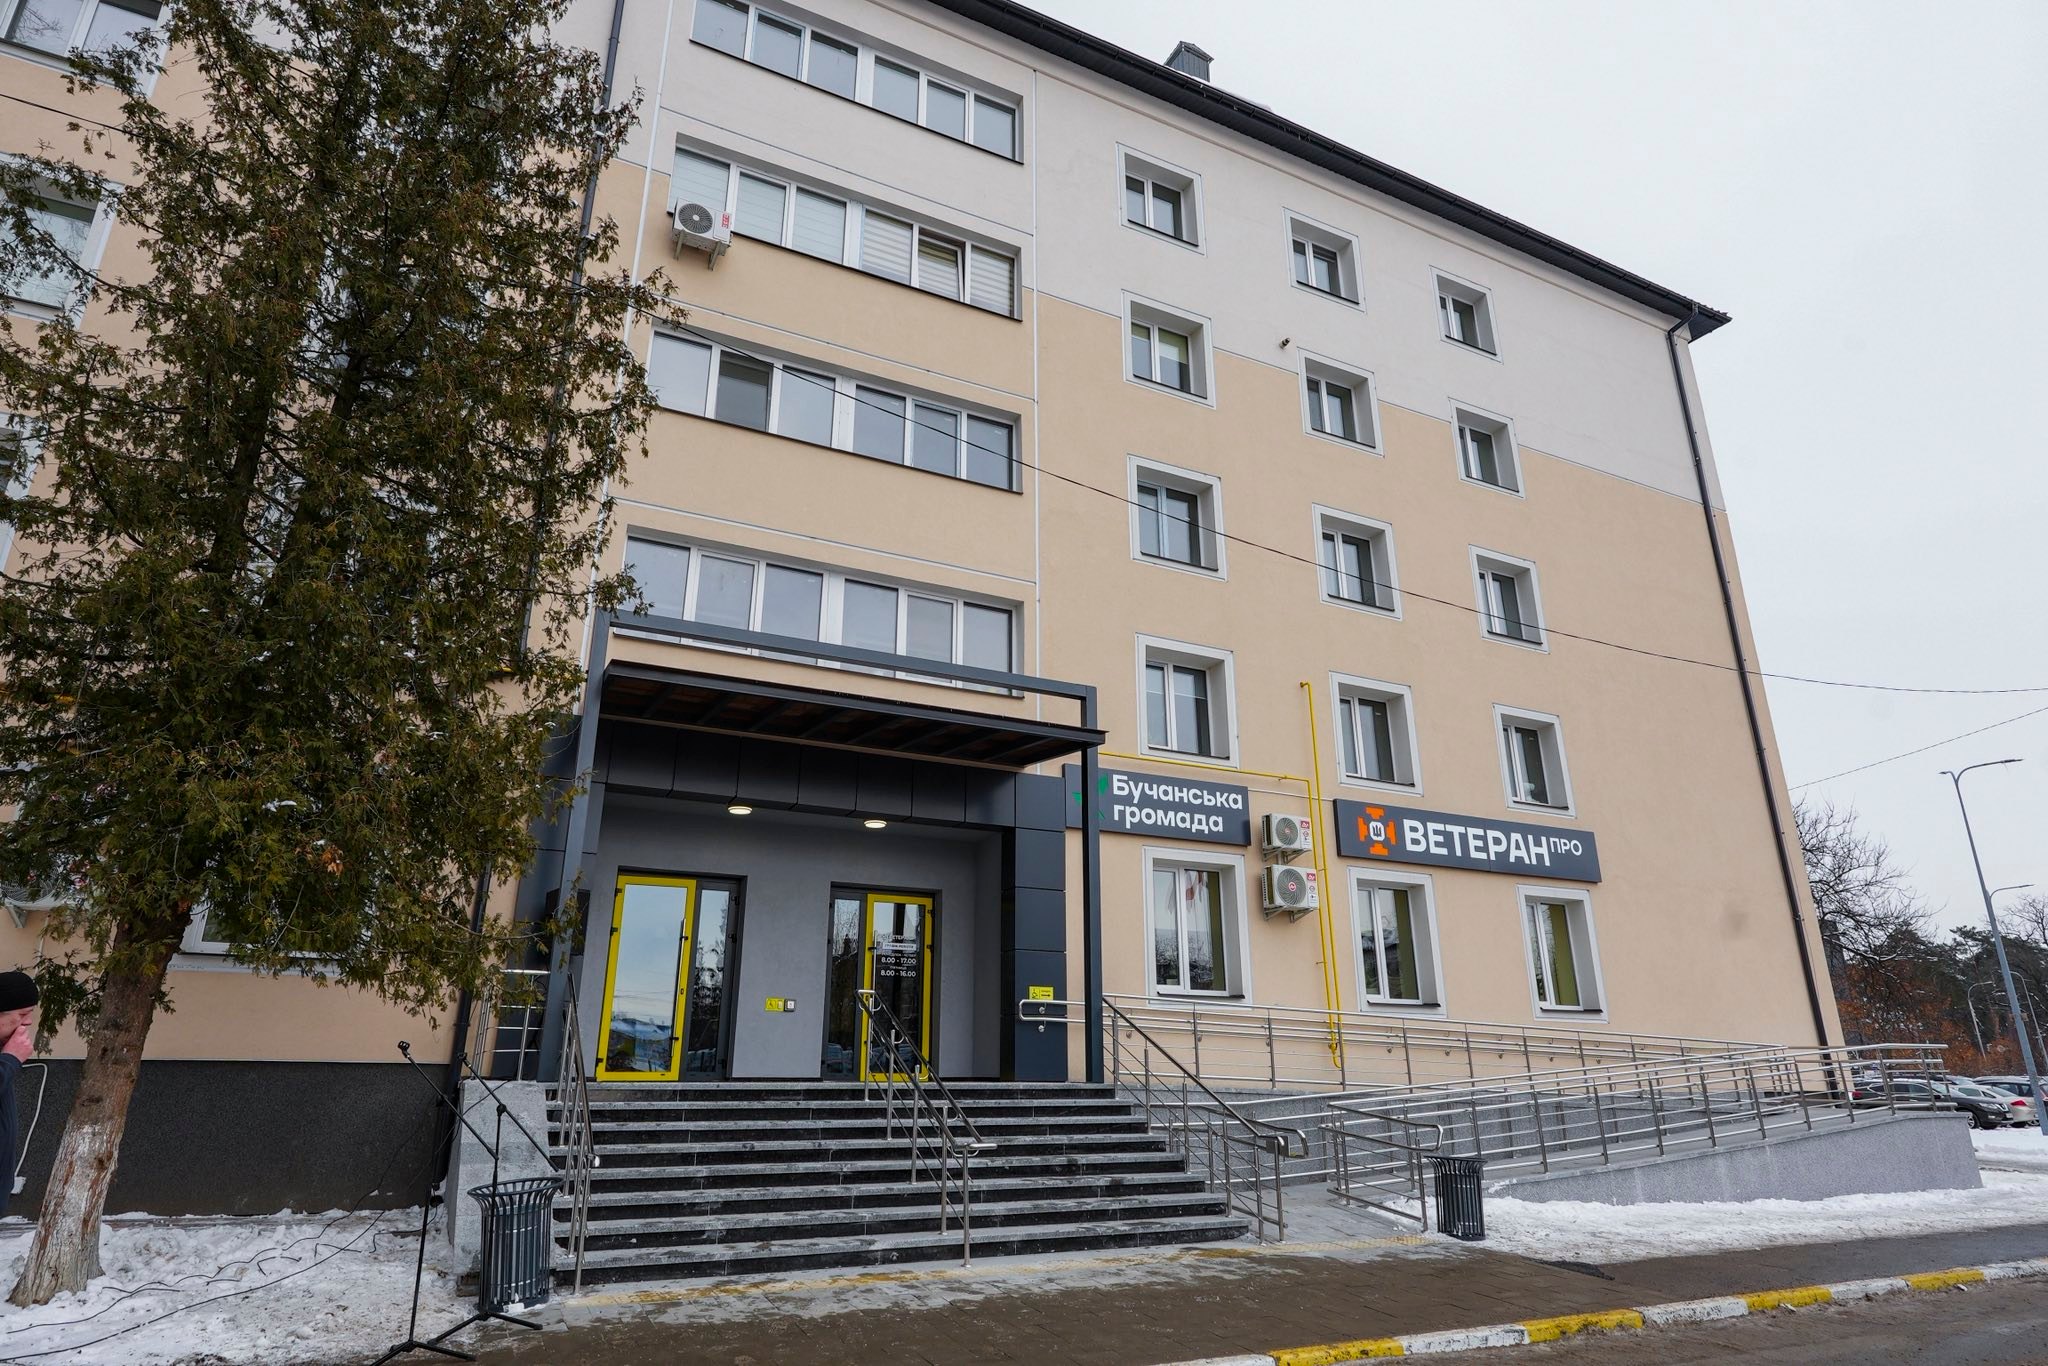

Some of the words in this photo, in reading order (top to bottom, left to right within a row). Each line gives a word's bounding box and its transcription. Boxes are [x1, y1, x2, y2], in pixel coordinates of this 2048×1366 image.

[1112, 774, 1243, 810] Бучанська
[1113, 804, 1224, 834] громада
[1402, 818, 1551, 867] ВЕТЕРАН
[1550, 837, 1583, 856] ПРО
